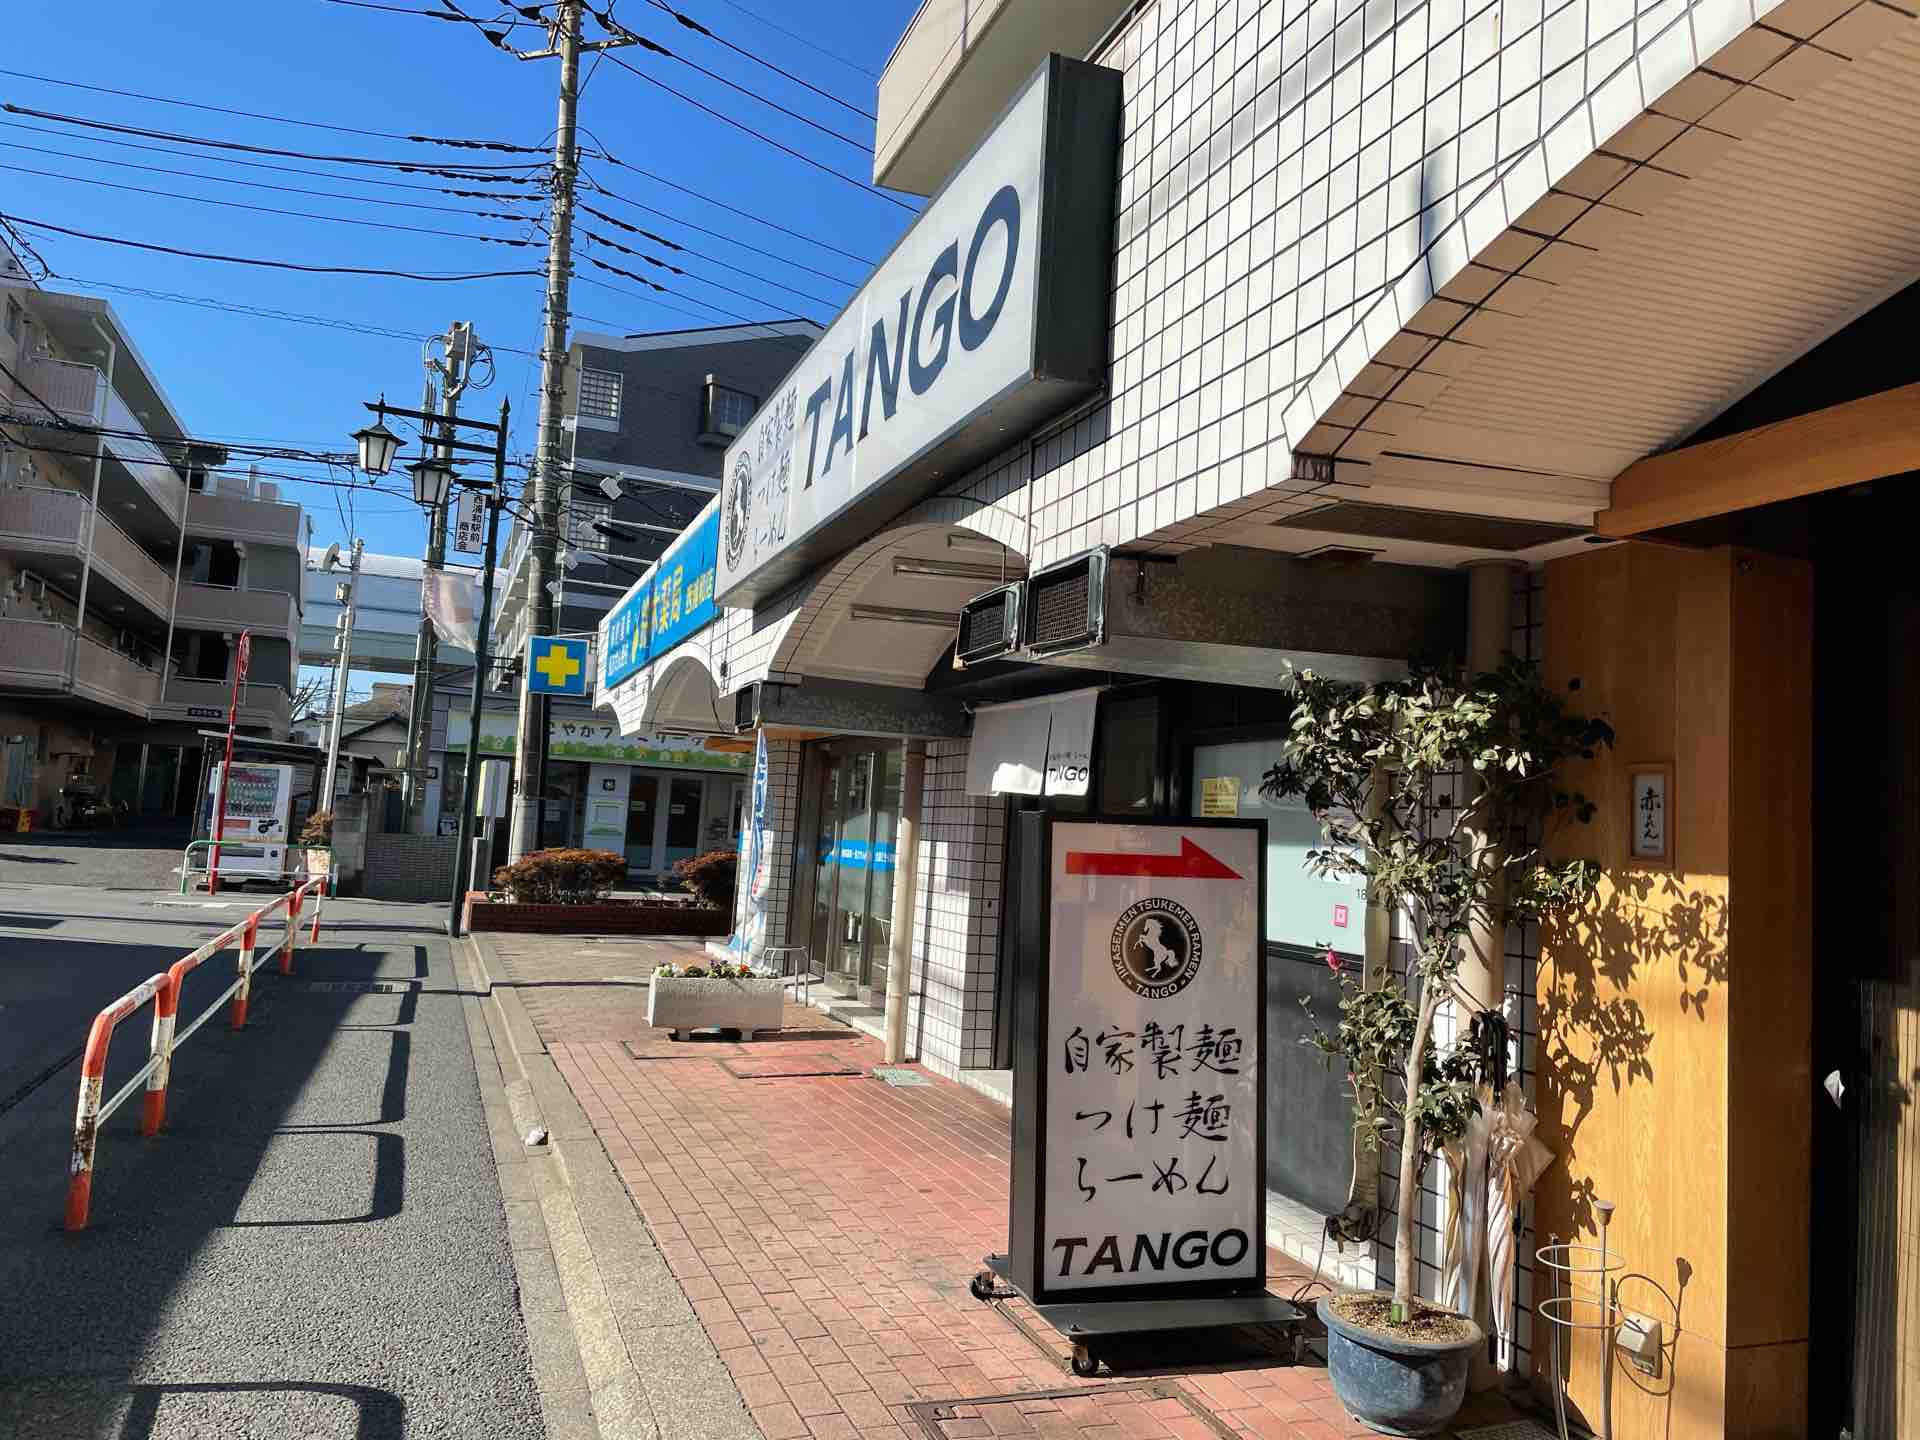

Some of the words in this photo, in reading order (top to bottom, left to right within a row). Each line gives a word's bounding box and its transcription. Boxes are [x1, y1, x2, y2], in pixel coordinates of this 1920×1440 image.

[803, 185, 1020, 490] TANGO
[1111, 906, 1138, 979] JIKASEIMEN
[1136, 898, 1196, 932] TSUKEMEN
[1183, 931, 1201, 980] RAMEN
[1135, 982, 1178, 999] TANGO
[1064, 1021, 1243, 1080] 自家製麺
[1072, 1090, 1232, 1142] つけ麺
[1076, 1154, 1230, 1202] らーめん
[1052, 1227, 1249, 1278] TANGO
